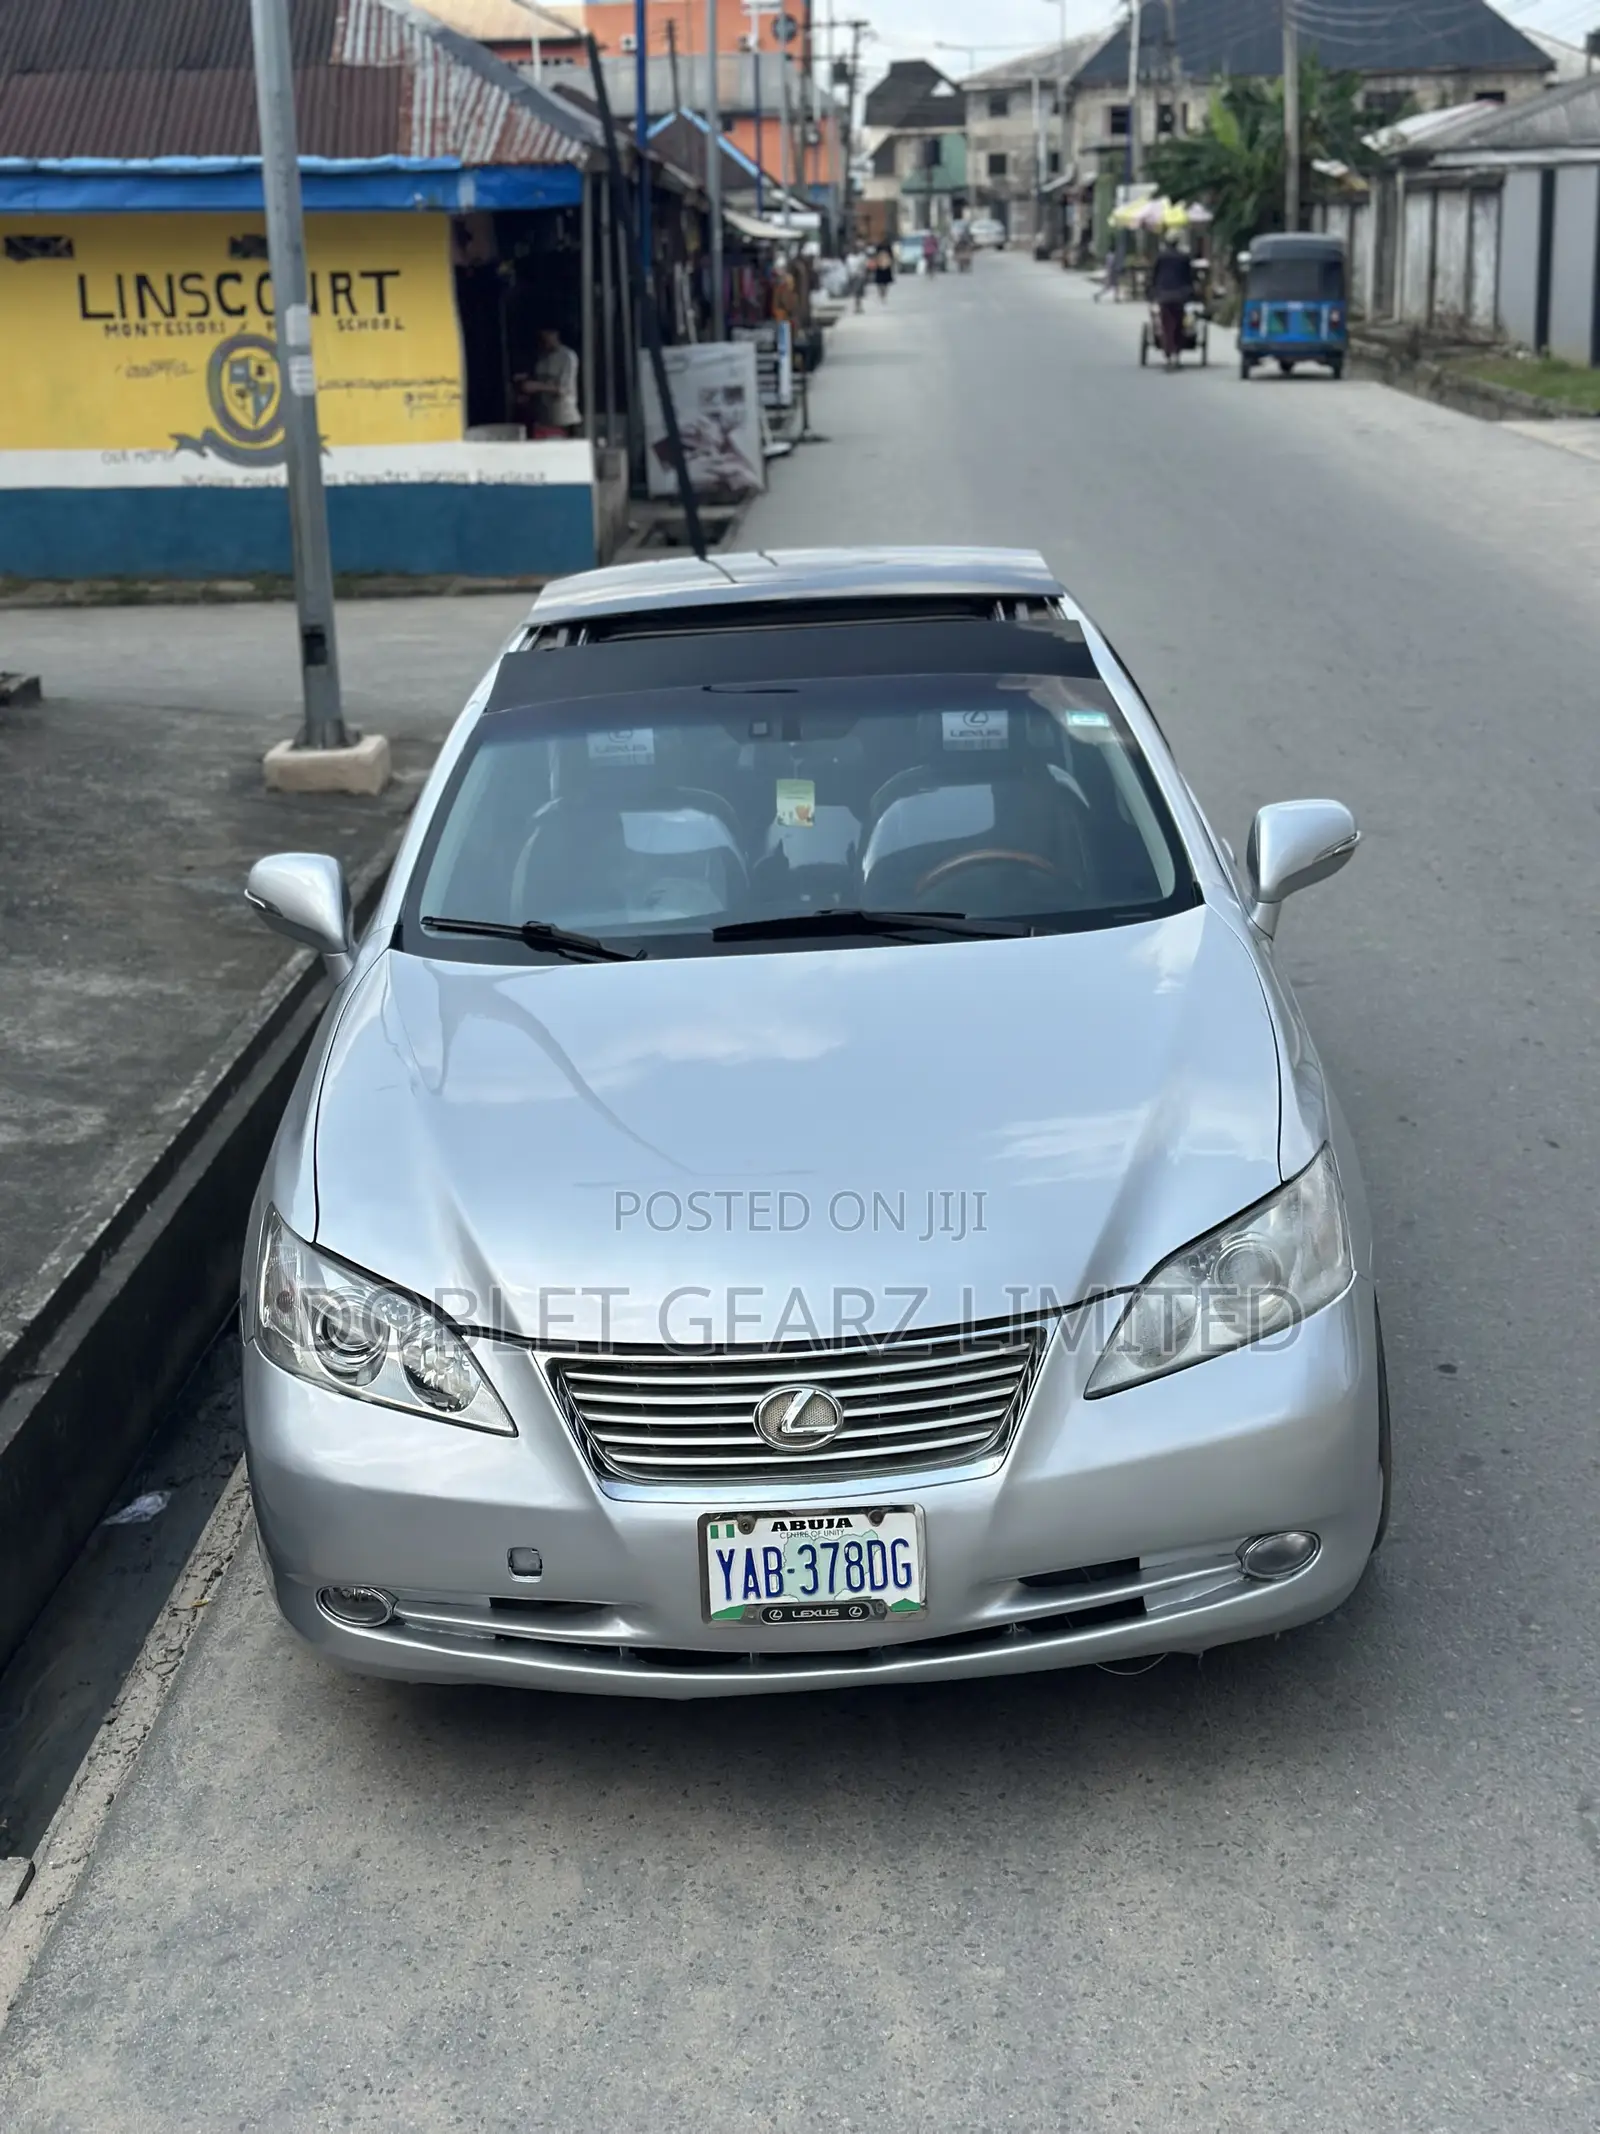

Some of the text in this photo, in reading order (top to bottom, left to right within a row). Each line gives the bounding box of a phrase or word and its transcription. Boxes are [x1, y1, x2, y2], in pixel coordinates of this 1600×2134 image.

[104, 317, 405, 338] MONTESSORI SCHOOL
[771, 1517, 853, 1532] ABUJA
[780, 1529, 845, 1539] CENTRE OF UNITY
[716, 1538, 913, 1602] YAB-378DG
[792, 1608, 840, 1618] LEXUS
